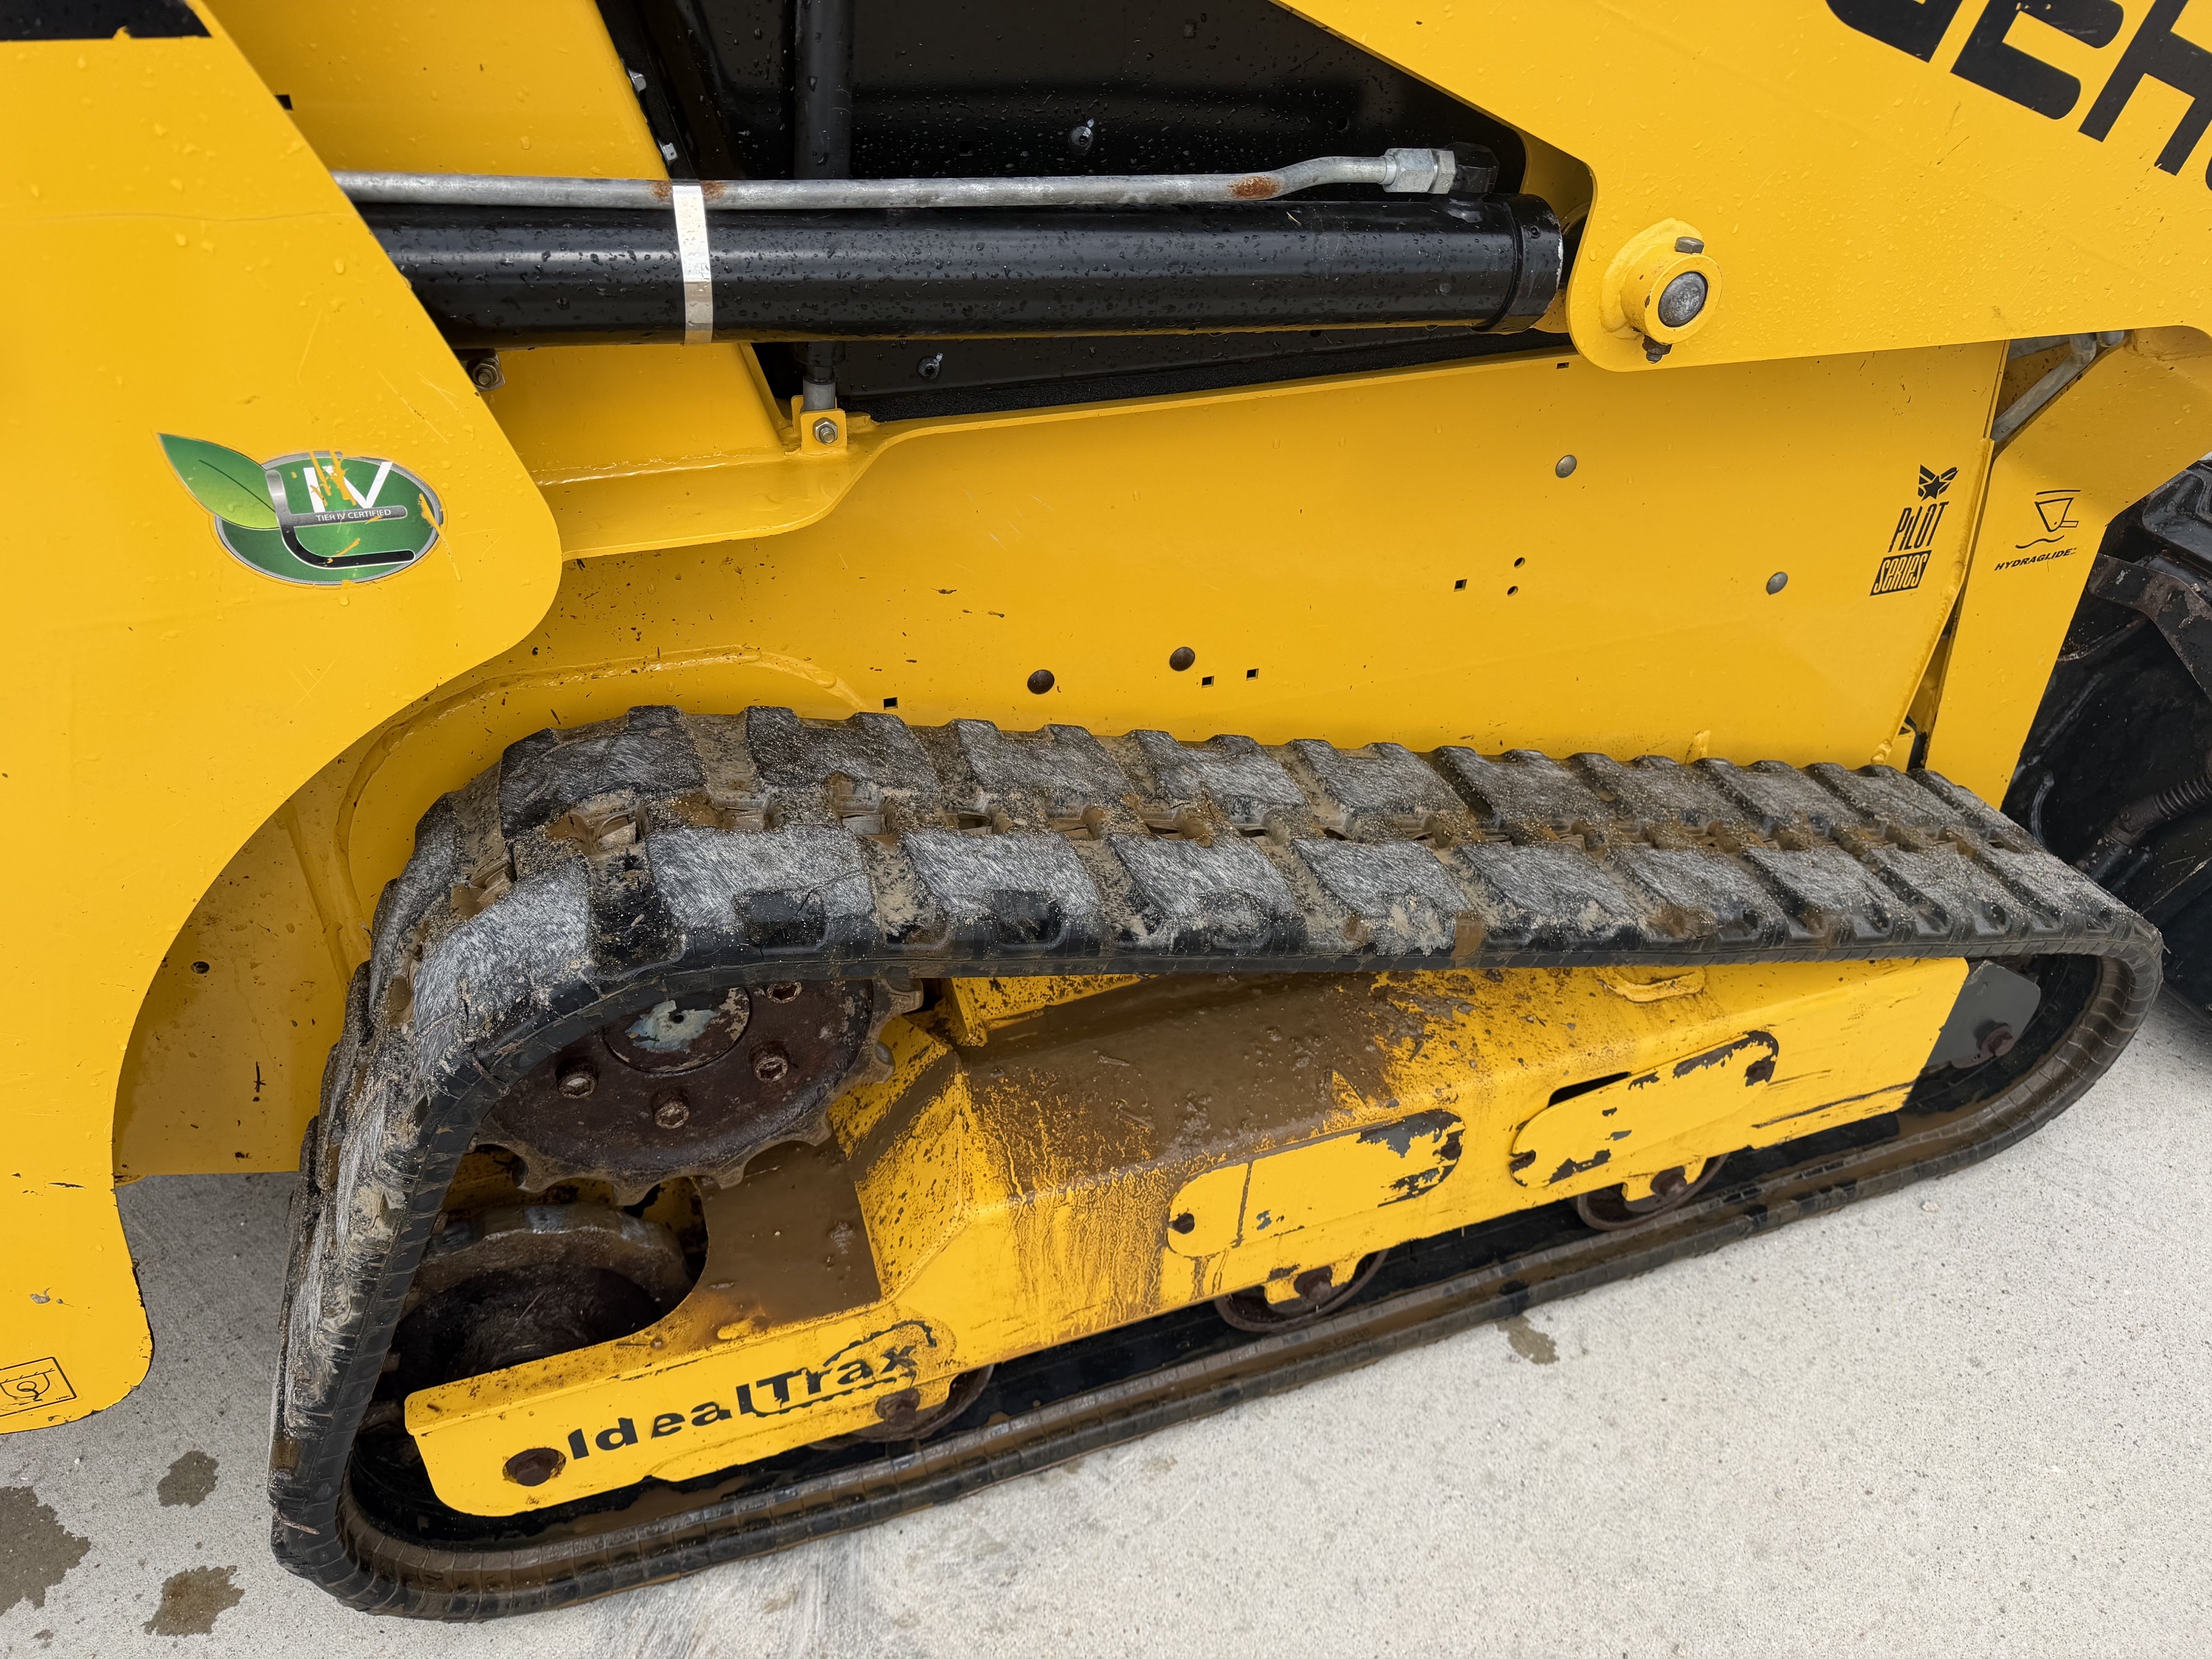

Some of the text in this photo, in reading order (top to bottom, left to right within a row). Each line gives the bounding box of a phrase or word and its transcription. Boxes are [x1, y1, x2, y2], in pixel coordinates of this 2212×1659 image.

[347, 509, 391, 519] CERTIFIED
[1887, 500, 1949, 553] PILOT
[568, 1341, 917, 1460] IdealTrax
